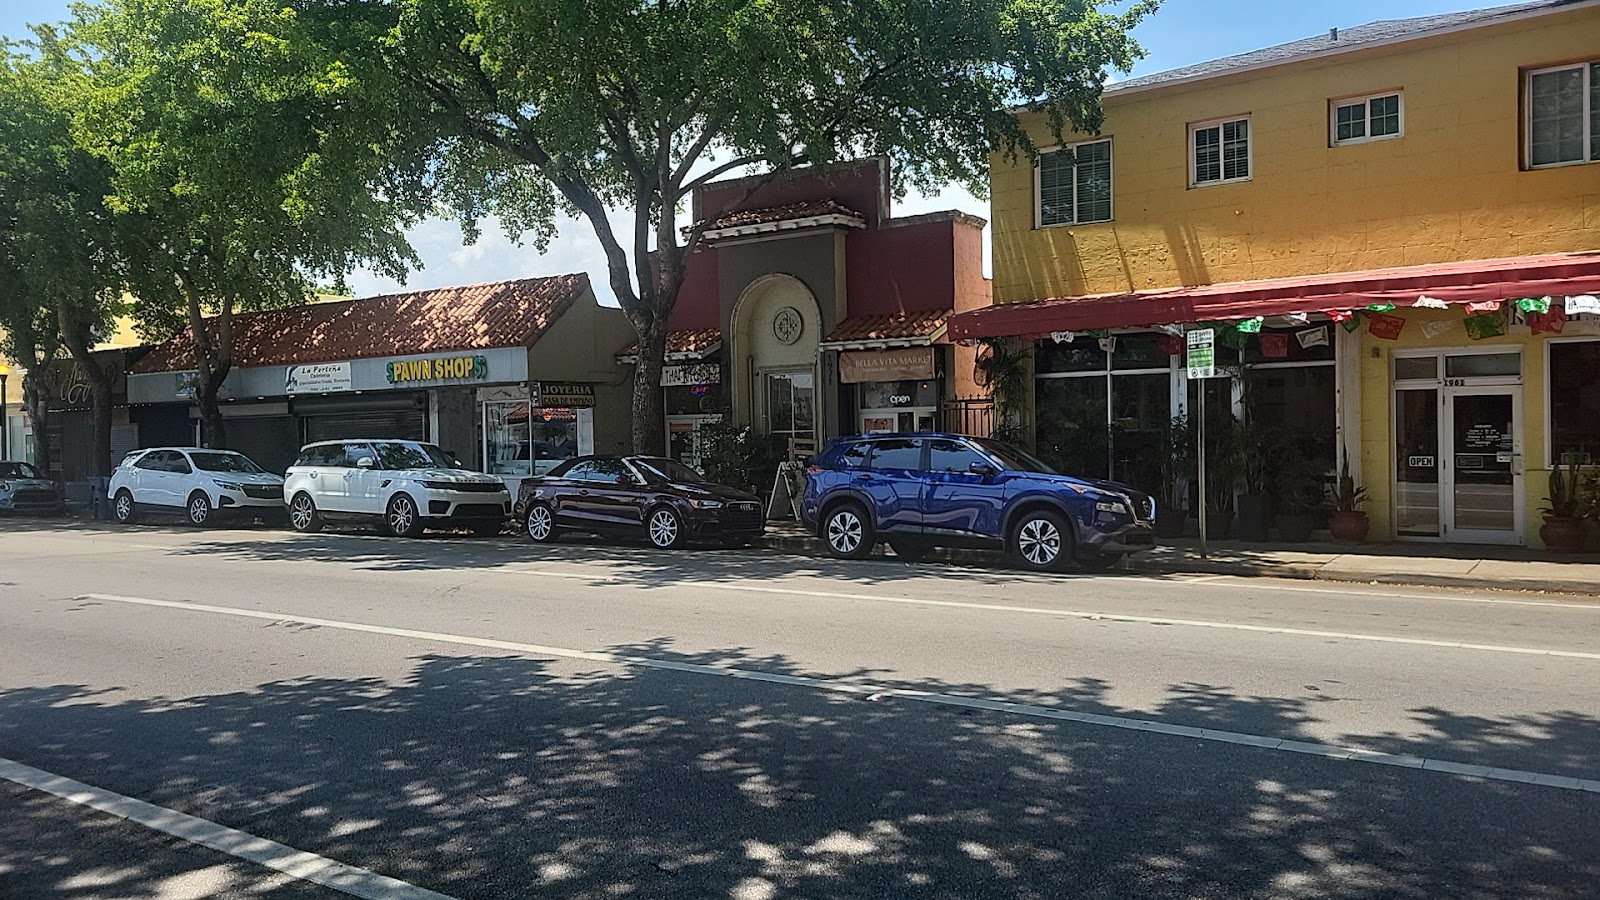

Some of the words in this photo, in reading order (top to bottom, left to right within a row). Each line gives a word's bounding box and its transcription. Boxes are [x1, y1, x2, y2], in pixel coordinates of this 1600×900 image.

[855, 359, 878, 368] BELLA
[880, 357, 897, 366] VITA
[899, 355, 931, 365] MARKET
[313, 365, 341, 373] Porteña
[542, 385, 592, 394] JOYERIA
[543, 397, 559, 405] CASA
[890, 395, 910, 404] open
[1410, 457, 1432, 466] OPEN
